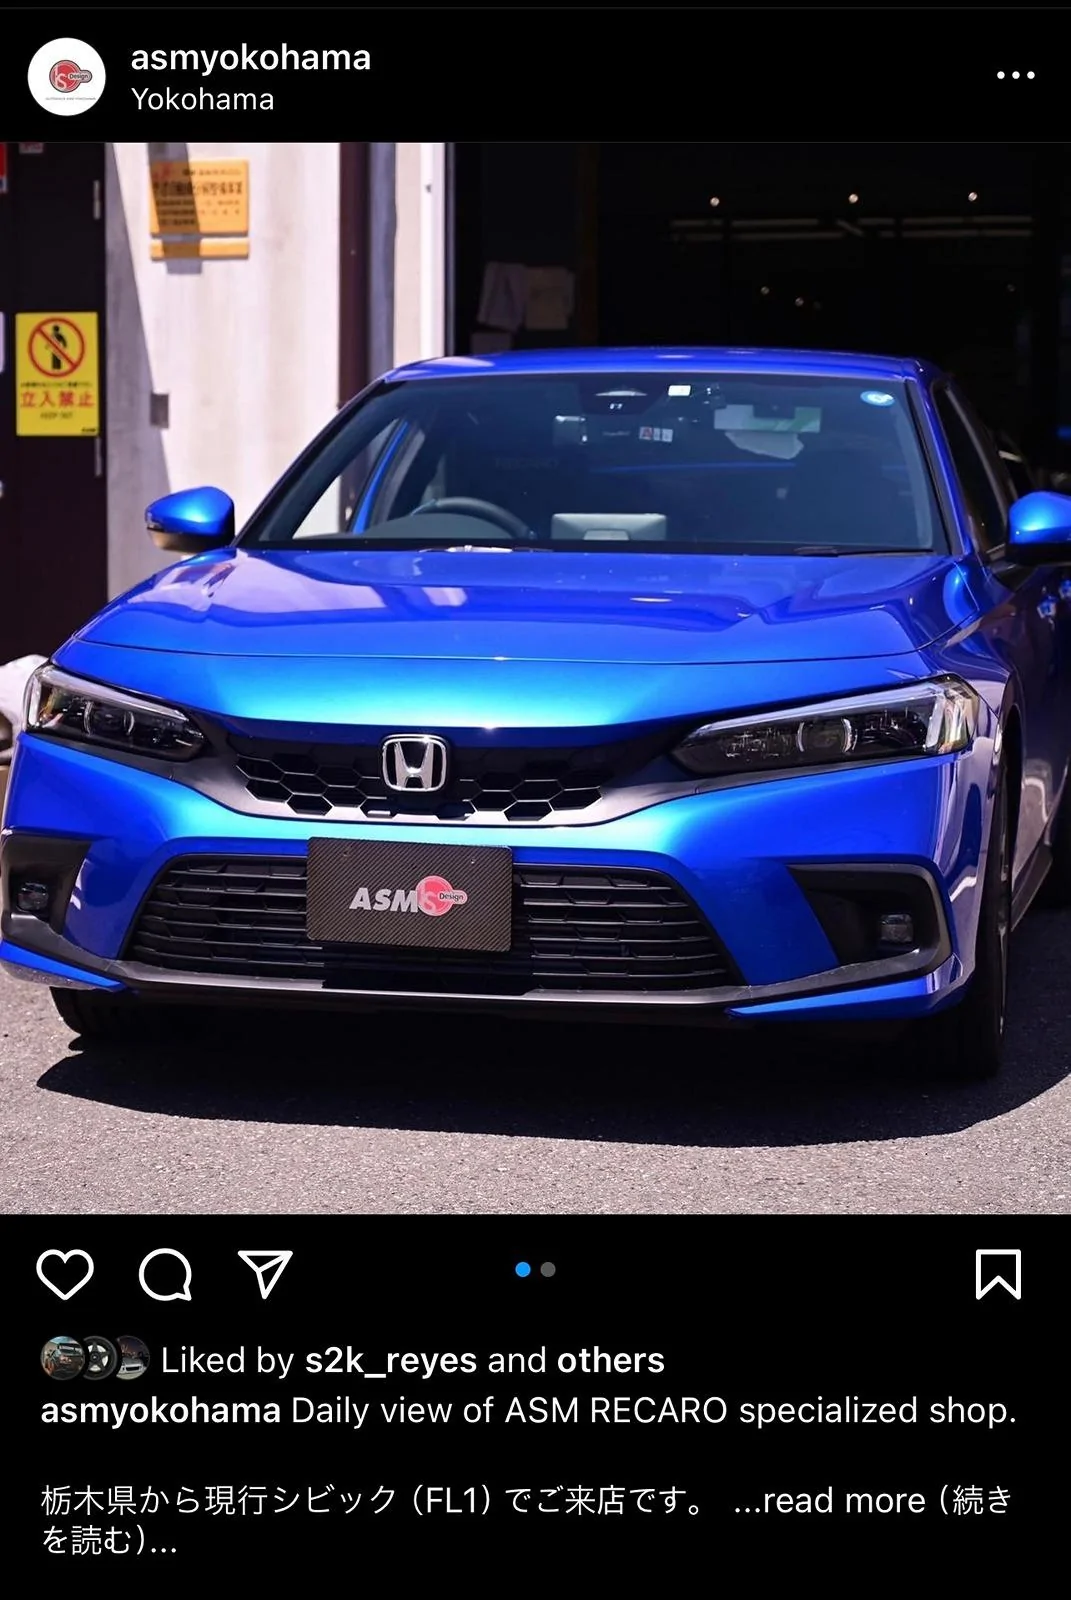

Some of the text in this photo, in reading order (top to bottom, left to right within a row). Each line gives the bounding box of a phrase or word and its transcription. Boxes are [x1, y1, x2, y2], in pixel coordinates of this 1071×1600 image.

[20, 390, 96, 408] 立入禁止
[349, 887, 418, 913] ASM
[439, 892, 464, 902] Design
